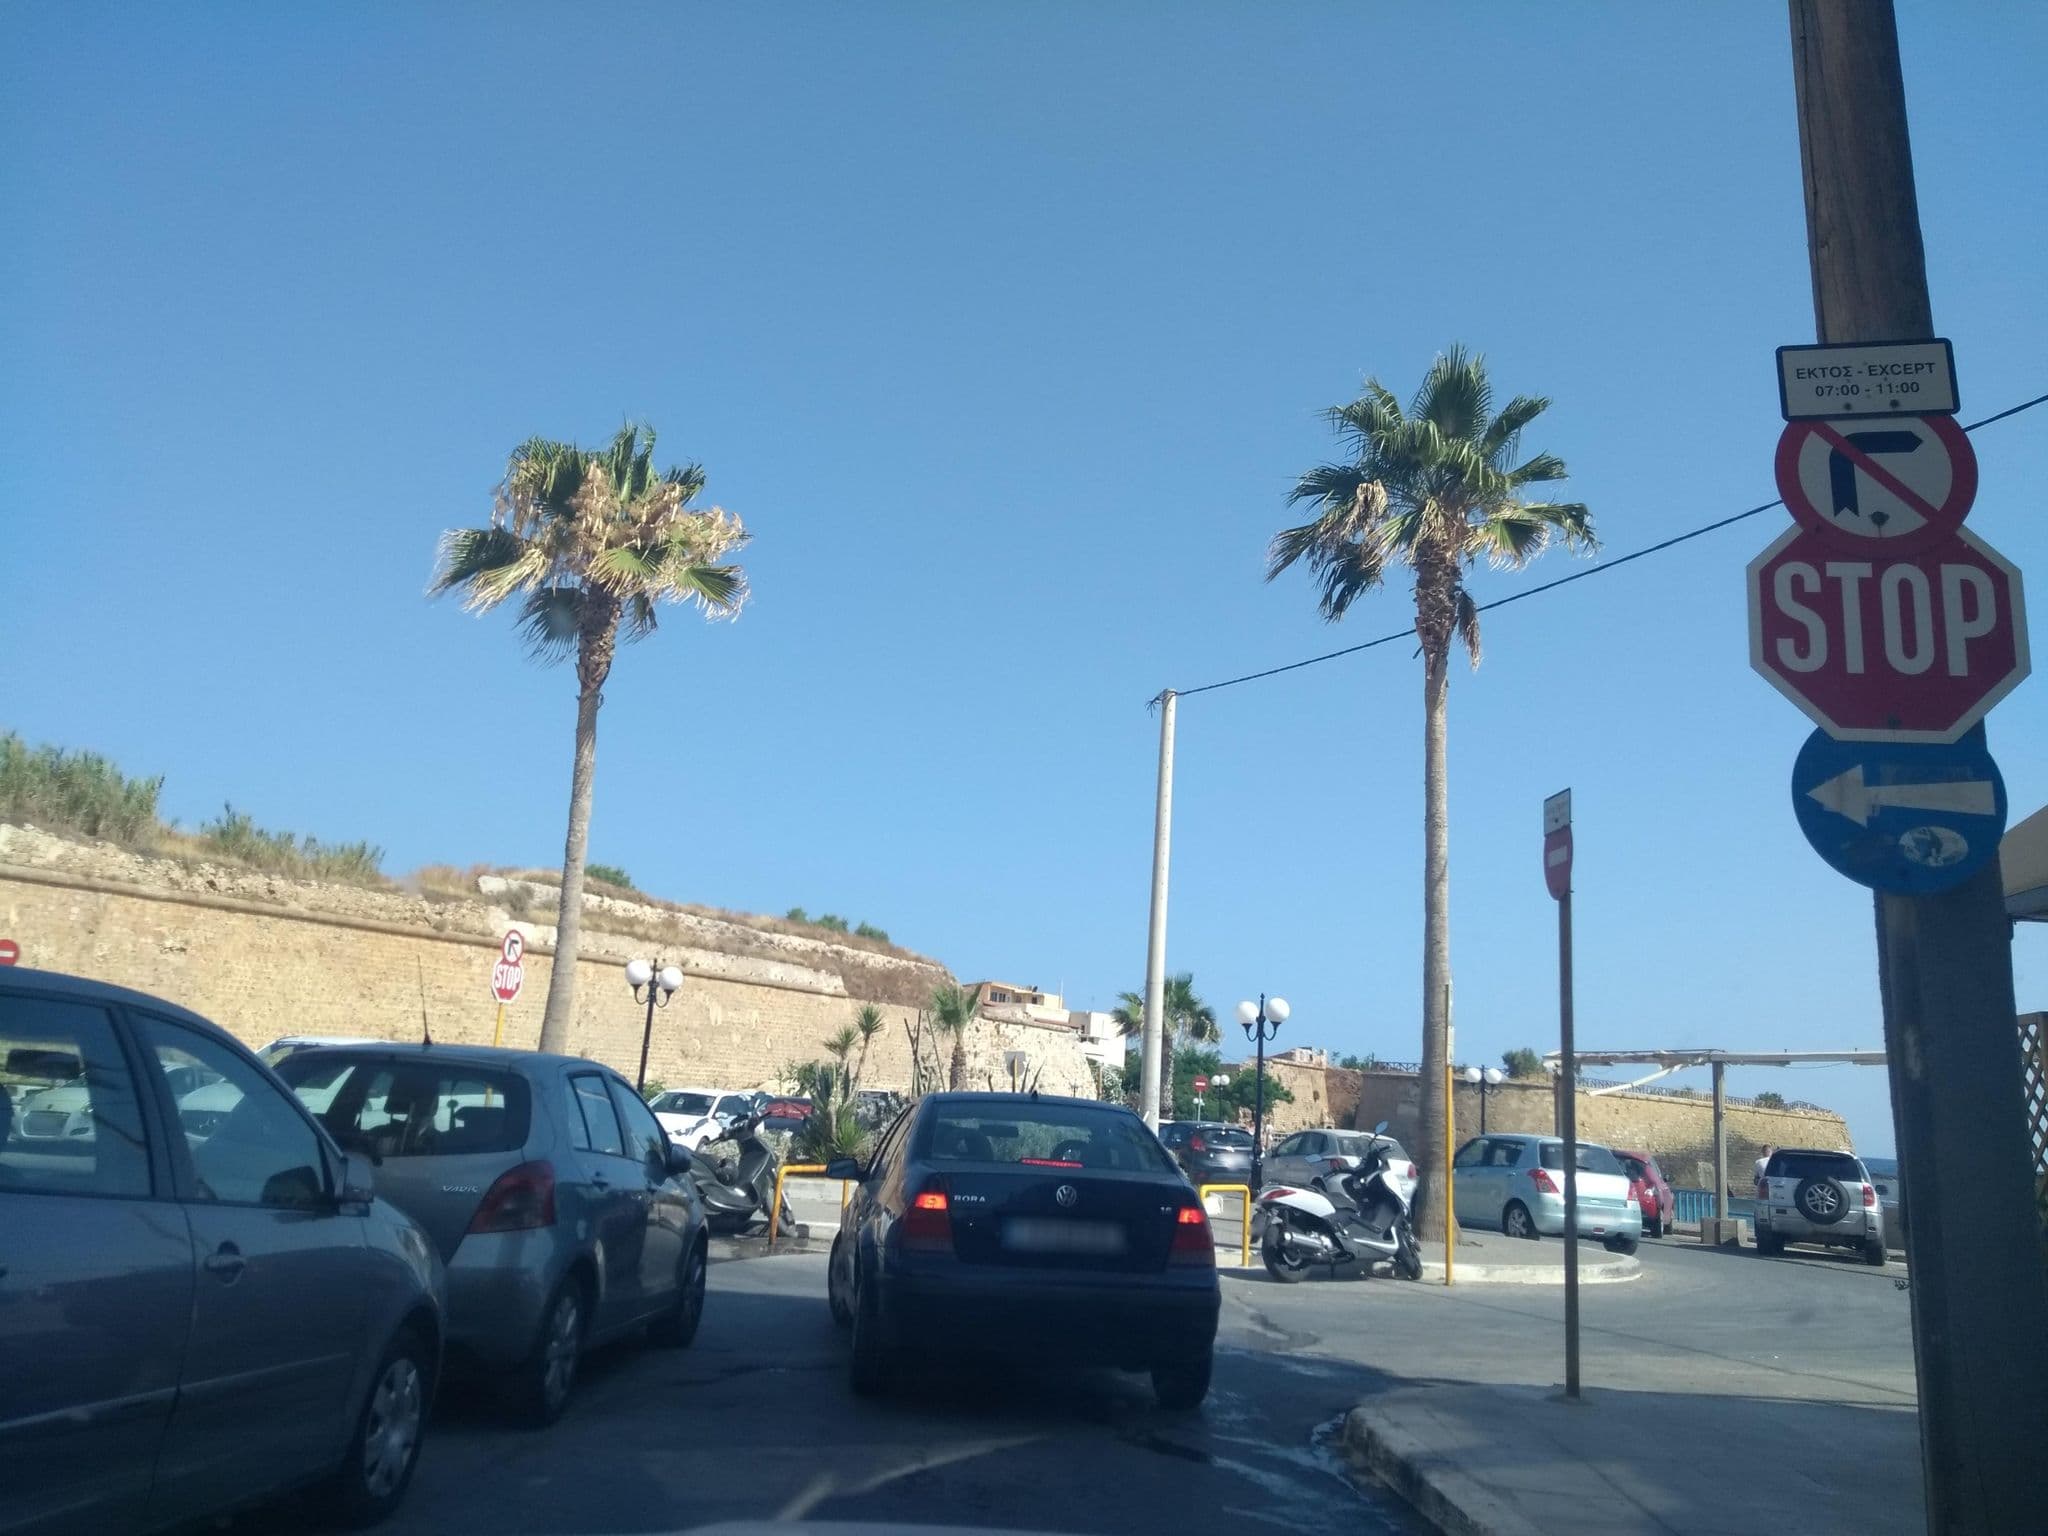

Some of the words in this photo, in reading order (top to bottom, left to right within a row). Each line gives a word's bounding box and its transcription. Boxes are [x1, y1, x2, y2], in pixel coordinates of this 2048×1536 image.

[1796, 366, 1853, 379] ΕΚΤΟΣ
[1868, 362, 1936, 377] EXCEPT
[1815, 384, 1860, 397] 07:00
[1876, 381, 1920, 395] 11:00
[1773, 560, 1998, 677] STOP
[495, 964, 521, 991] STOP
[953, 1194, 986, 1203] BORA
